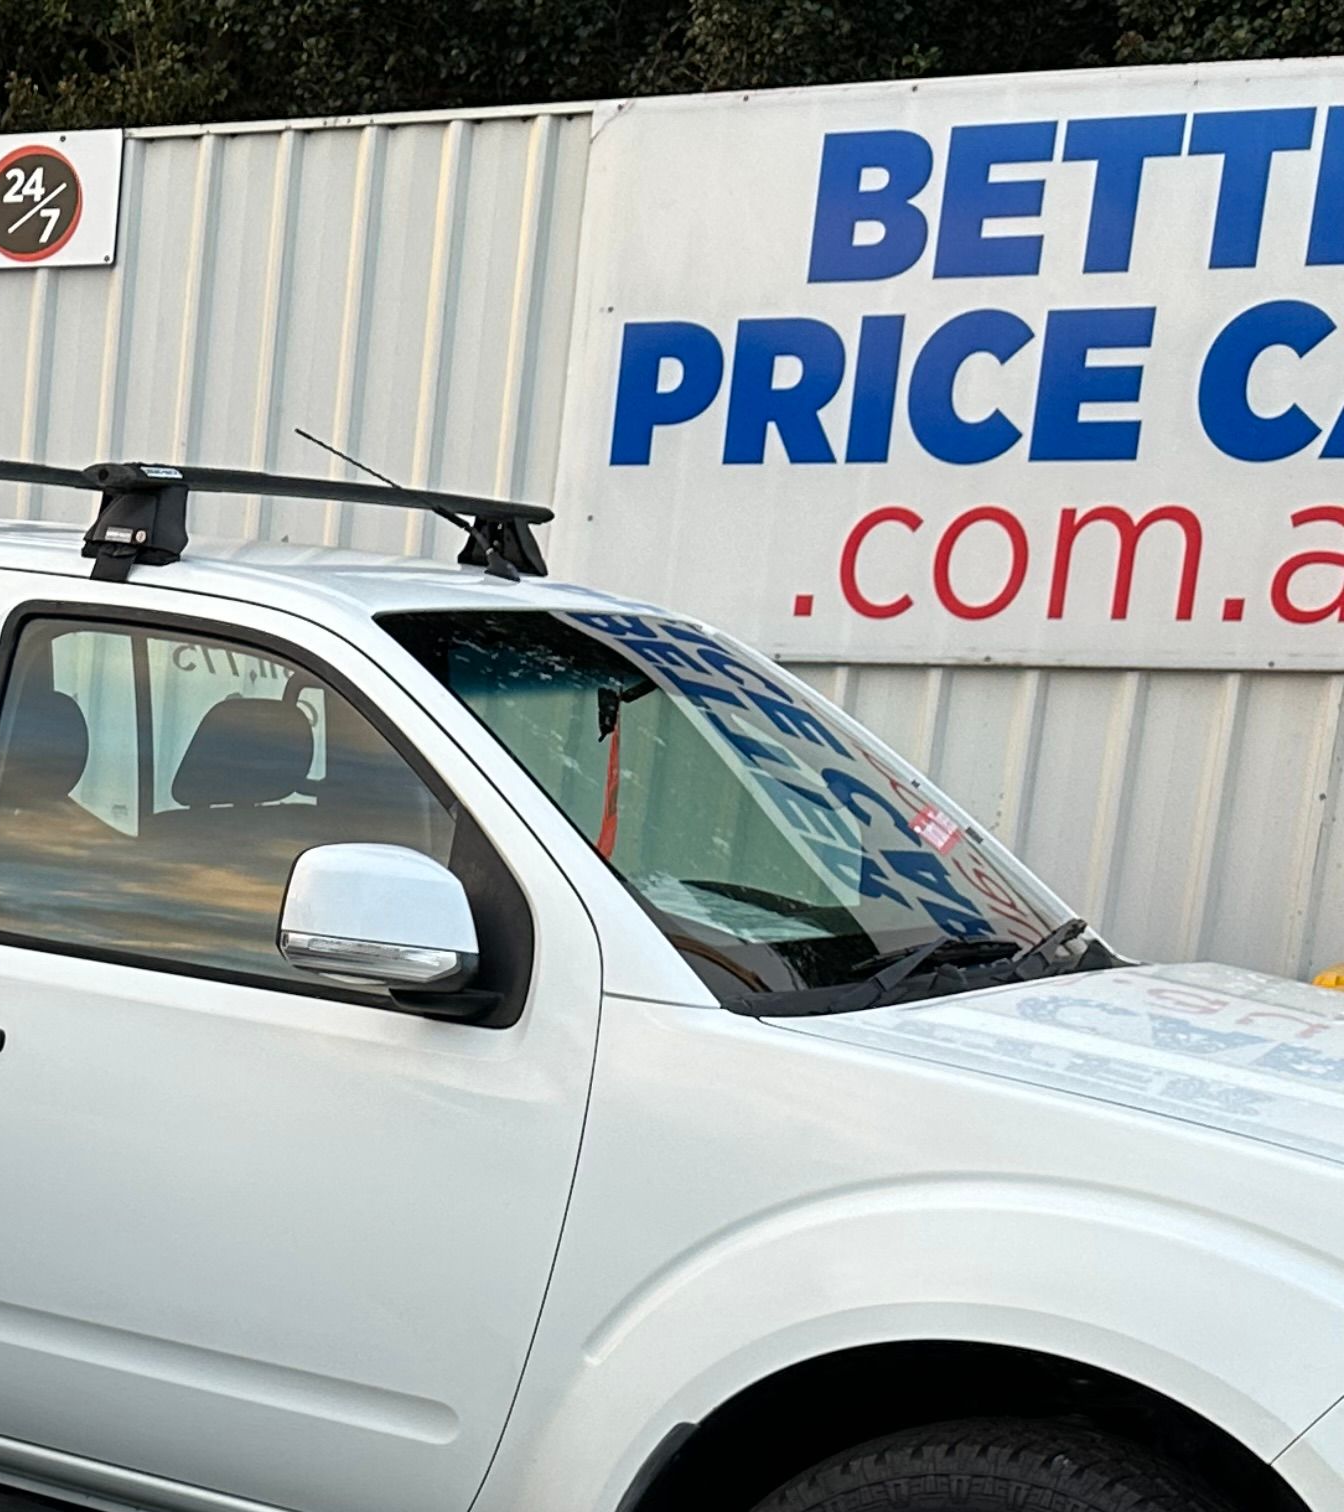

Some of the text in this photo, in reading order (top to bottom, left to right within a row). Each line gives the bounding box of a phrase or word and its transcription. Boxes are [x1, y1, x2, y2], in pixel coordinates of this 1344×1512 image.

[806, 105, 1344, 284] BETT
[608, 298, 1344, 467] PRICE C
